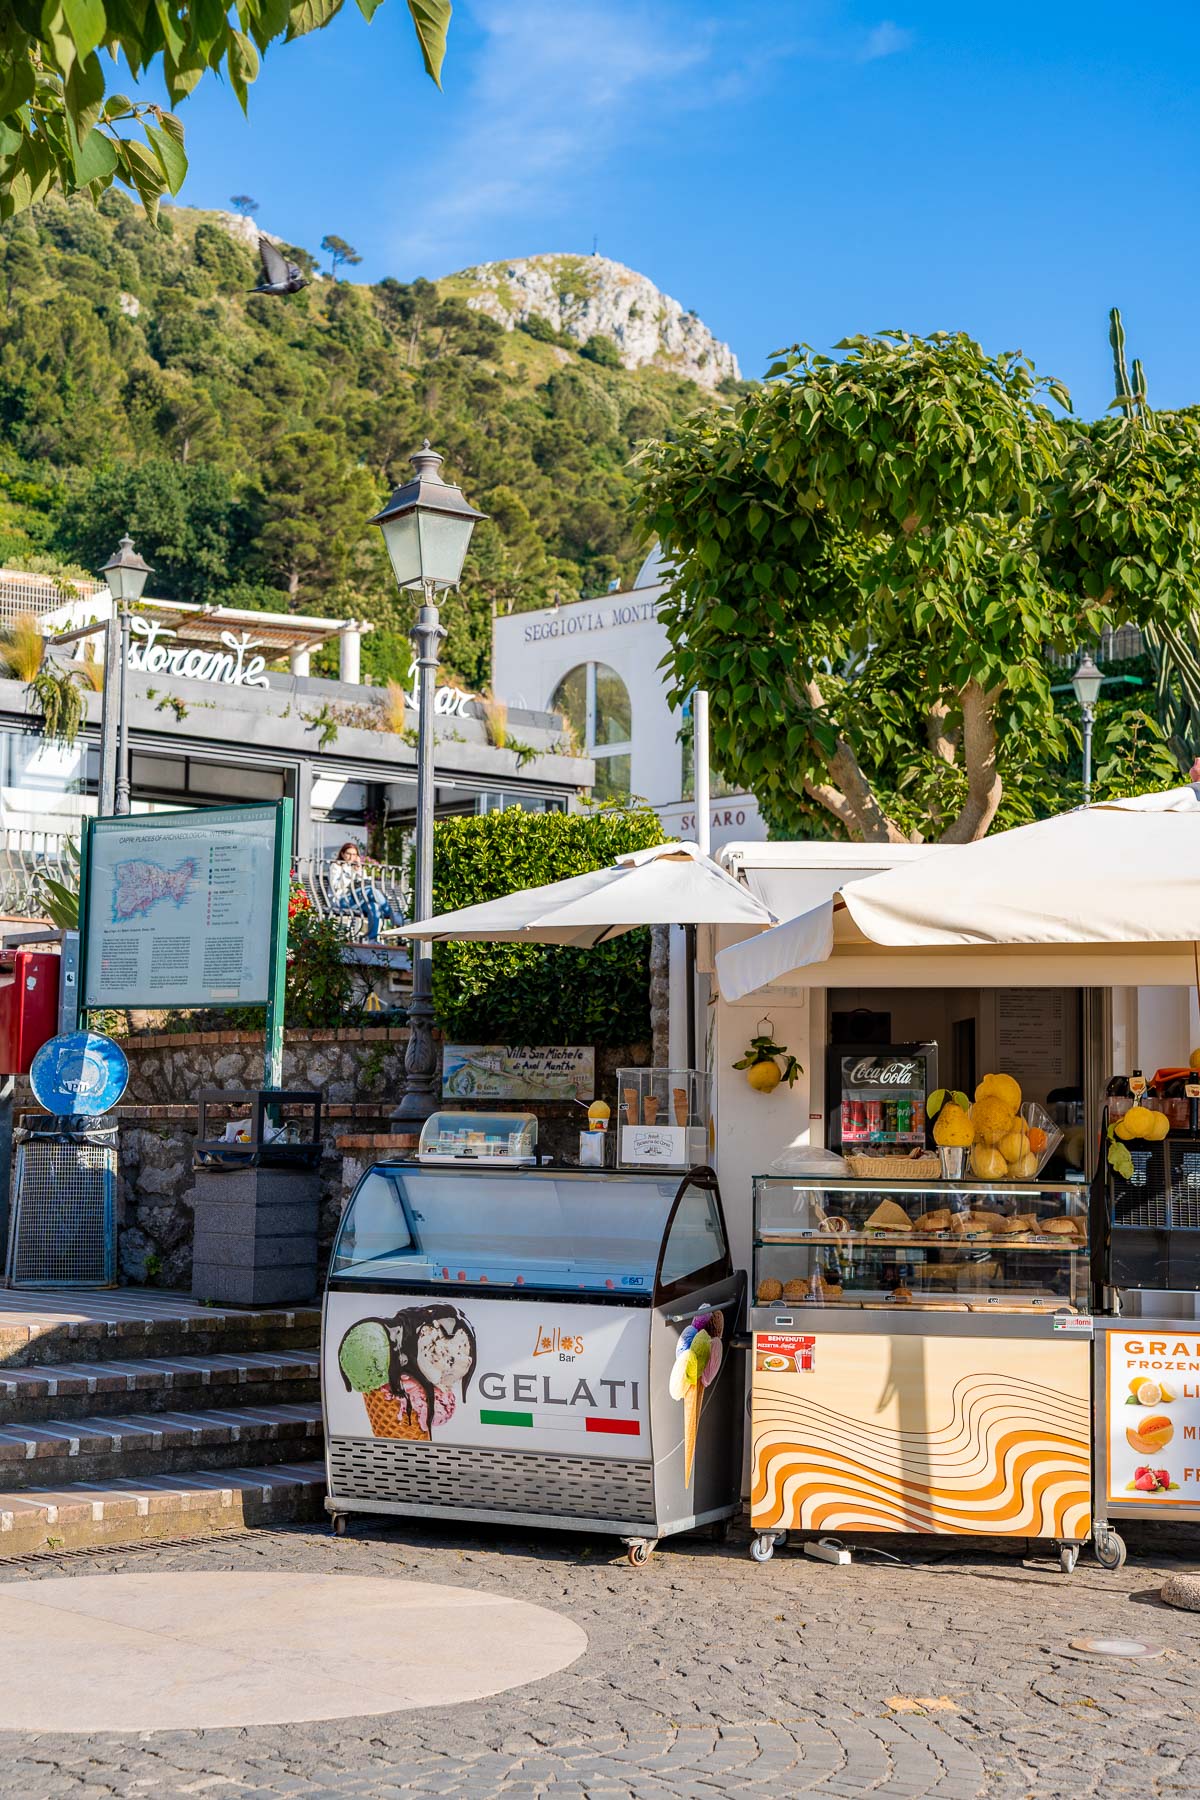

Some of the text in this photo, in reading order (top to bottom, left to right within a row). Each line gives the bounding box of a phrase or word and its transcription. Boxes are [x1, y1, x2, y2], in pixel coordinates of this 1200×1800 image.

[524, 613, 603, 642] SEGGIOVIA
[681, 810, 745, 831] SARO
[506, 1046, 584, 1060] Villa San Michele
[544, 1061, 576, 1071] Munthe
[850, 1063, 916, 1085] Coca-Cola
[533, 1326, 584, 1357] Lollo's
[559, 1353, 576, 1363] Bar
[1126, 1360, 1200, 1371] FROZEN
[478, 1372, 640, 1410] GELATI
[1183, 1425, 1200, 1440] M
